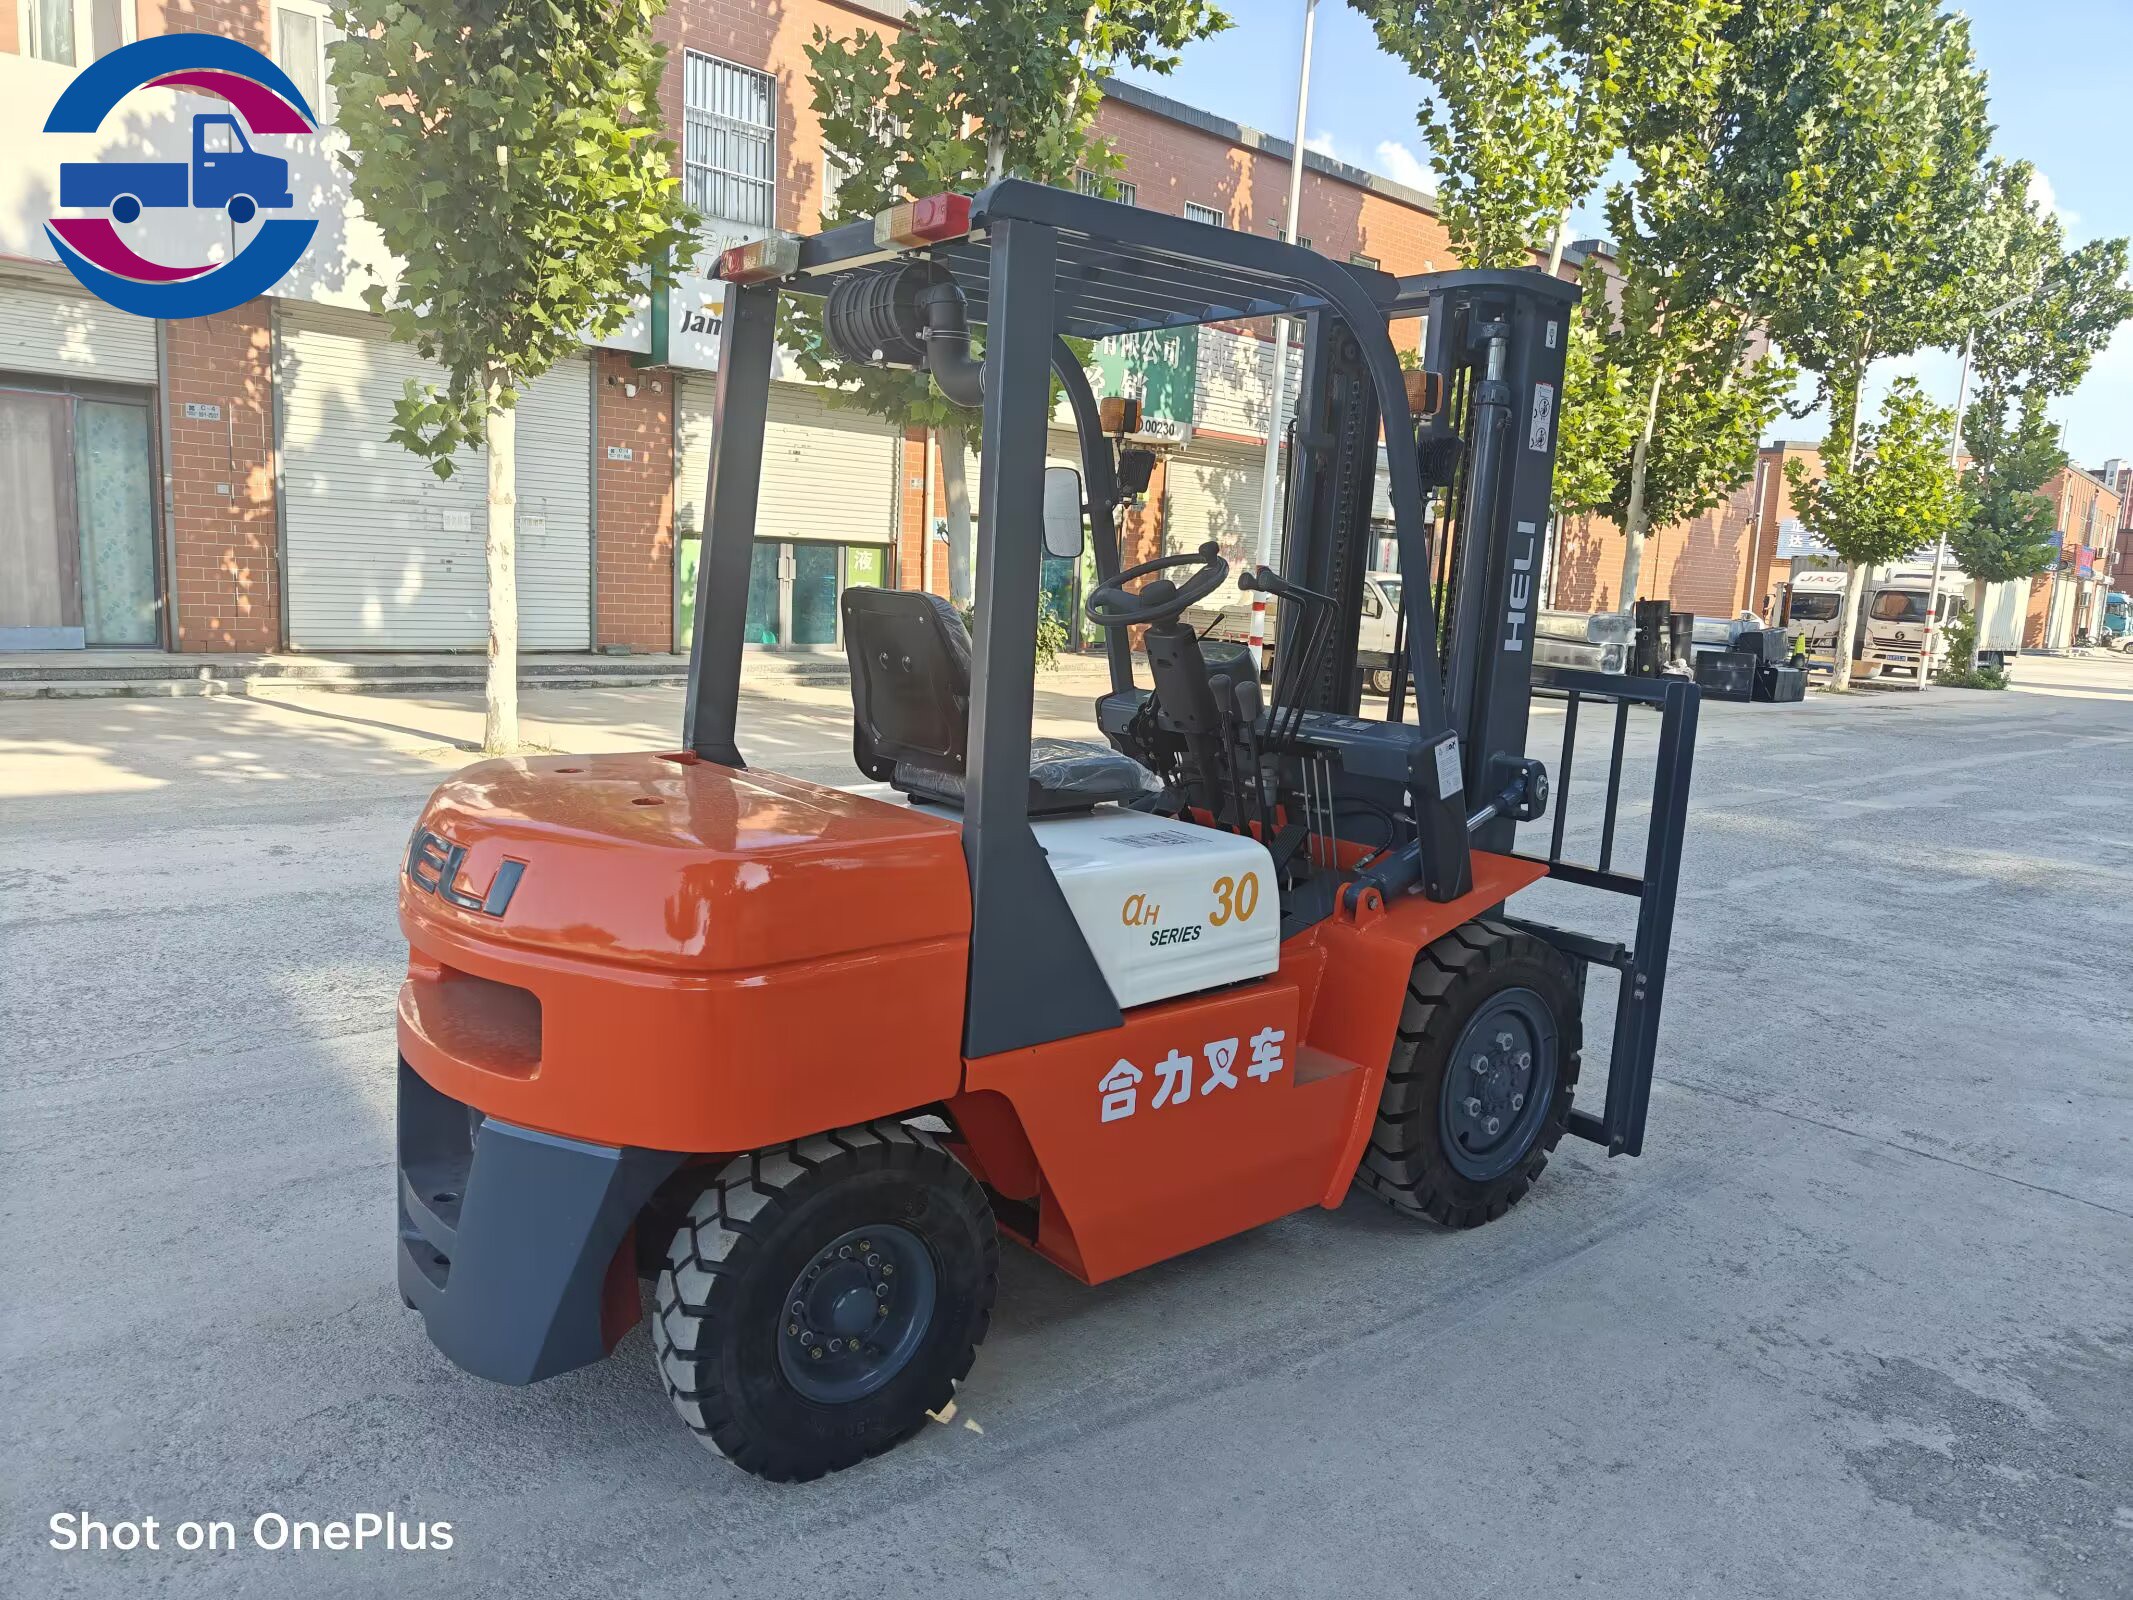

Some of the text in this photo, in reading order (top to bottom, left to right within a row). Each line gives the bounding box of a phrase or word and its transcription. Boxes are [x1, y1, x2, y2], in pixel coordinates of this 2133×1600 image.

[1504, 521, 1536, 652] HELI
[1800, 575, 1840, 583] JAC
[1209, 872, 1259, 927] 30
[1150, 925, 1202, 947] SERIES
[1098, 1026, 1285, 1123] 合力叉车
